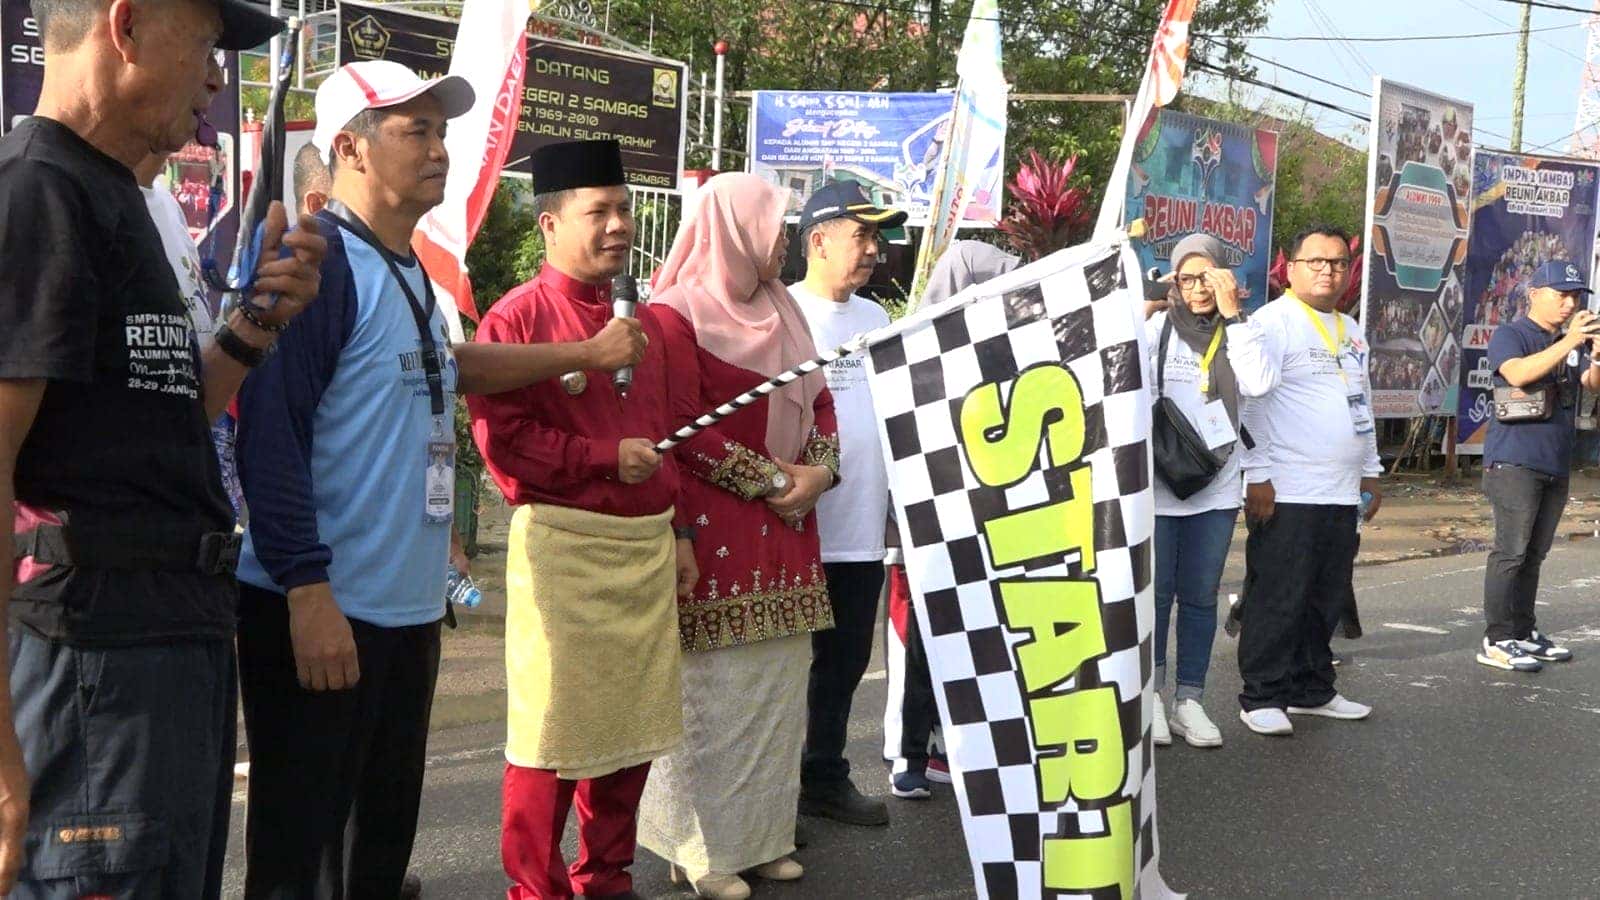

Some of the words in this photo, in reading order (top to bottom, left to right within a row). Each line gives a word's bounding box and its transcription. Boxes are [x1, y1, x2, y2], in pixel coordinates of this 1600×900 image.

[535, 58, 610, 85] DATANG
[520, 87, 564, 105] EGERI
[568, 94, 579, 109] 2
[583, 98, 648, 119] SAMBAS
[535, 107, 599, 127] 1969-2010
[518, 122, 571, 139] ENJALIN
[631, 172, 671, 187] SAMBAS
[1538, 170, 1573, 187] SAMBAS
[1506, 186, 1535, 201] REUNI
[1536, 189, 1570, 205] AKBAR
[1142, 192, 1198, 245] REUNI
[1201, 201, 1257, 256] AKBAR
[126, 313, 160, 325] SMPN
[126, 325, 184, 347] REUNI
[959, 363, 1136, 900] START
